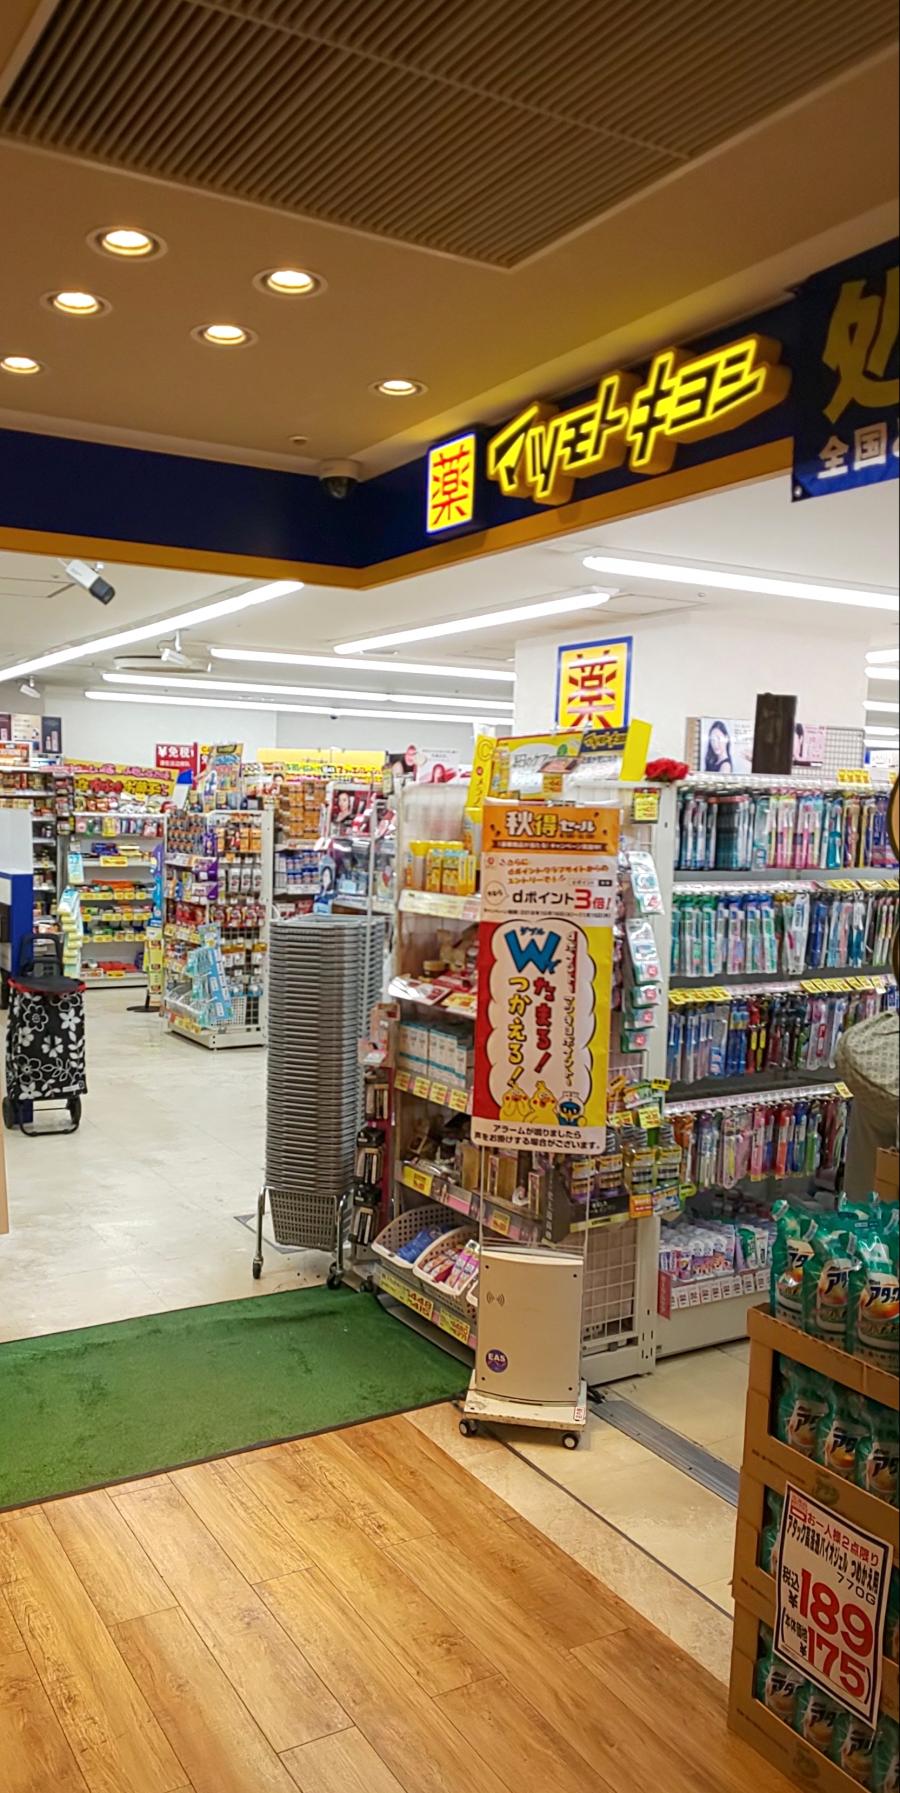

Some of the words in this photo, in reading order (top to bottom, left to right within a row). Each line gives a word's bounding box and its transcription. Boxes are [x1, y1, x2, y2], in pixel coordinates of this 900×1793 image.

[432, 444, 469, 525] 薬
[488, 338, 767, 499] マツモトキヨシ
[817, 418, 899, 479] 全国
[567, 649, 618, 730] 薬
[504, 809, 596, 838] 秋得セール
[488, 1353, 506, 1364] EAS
